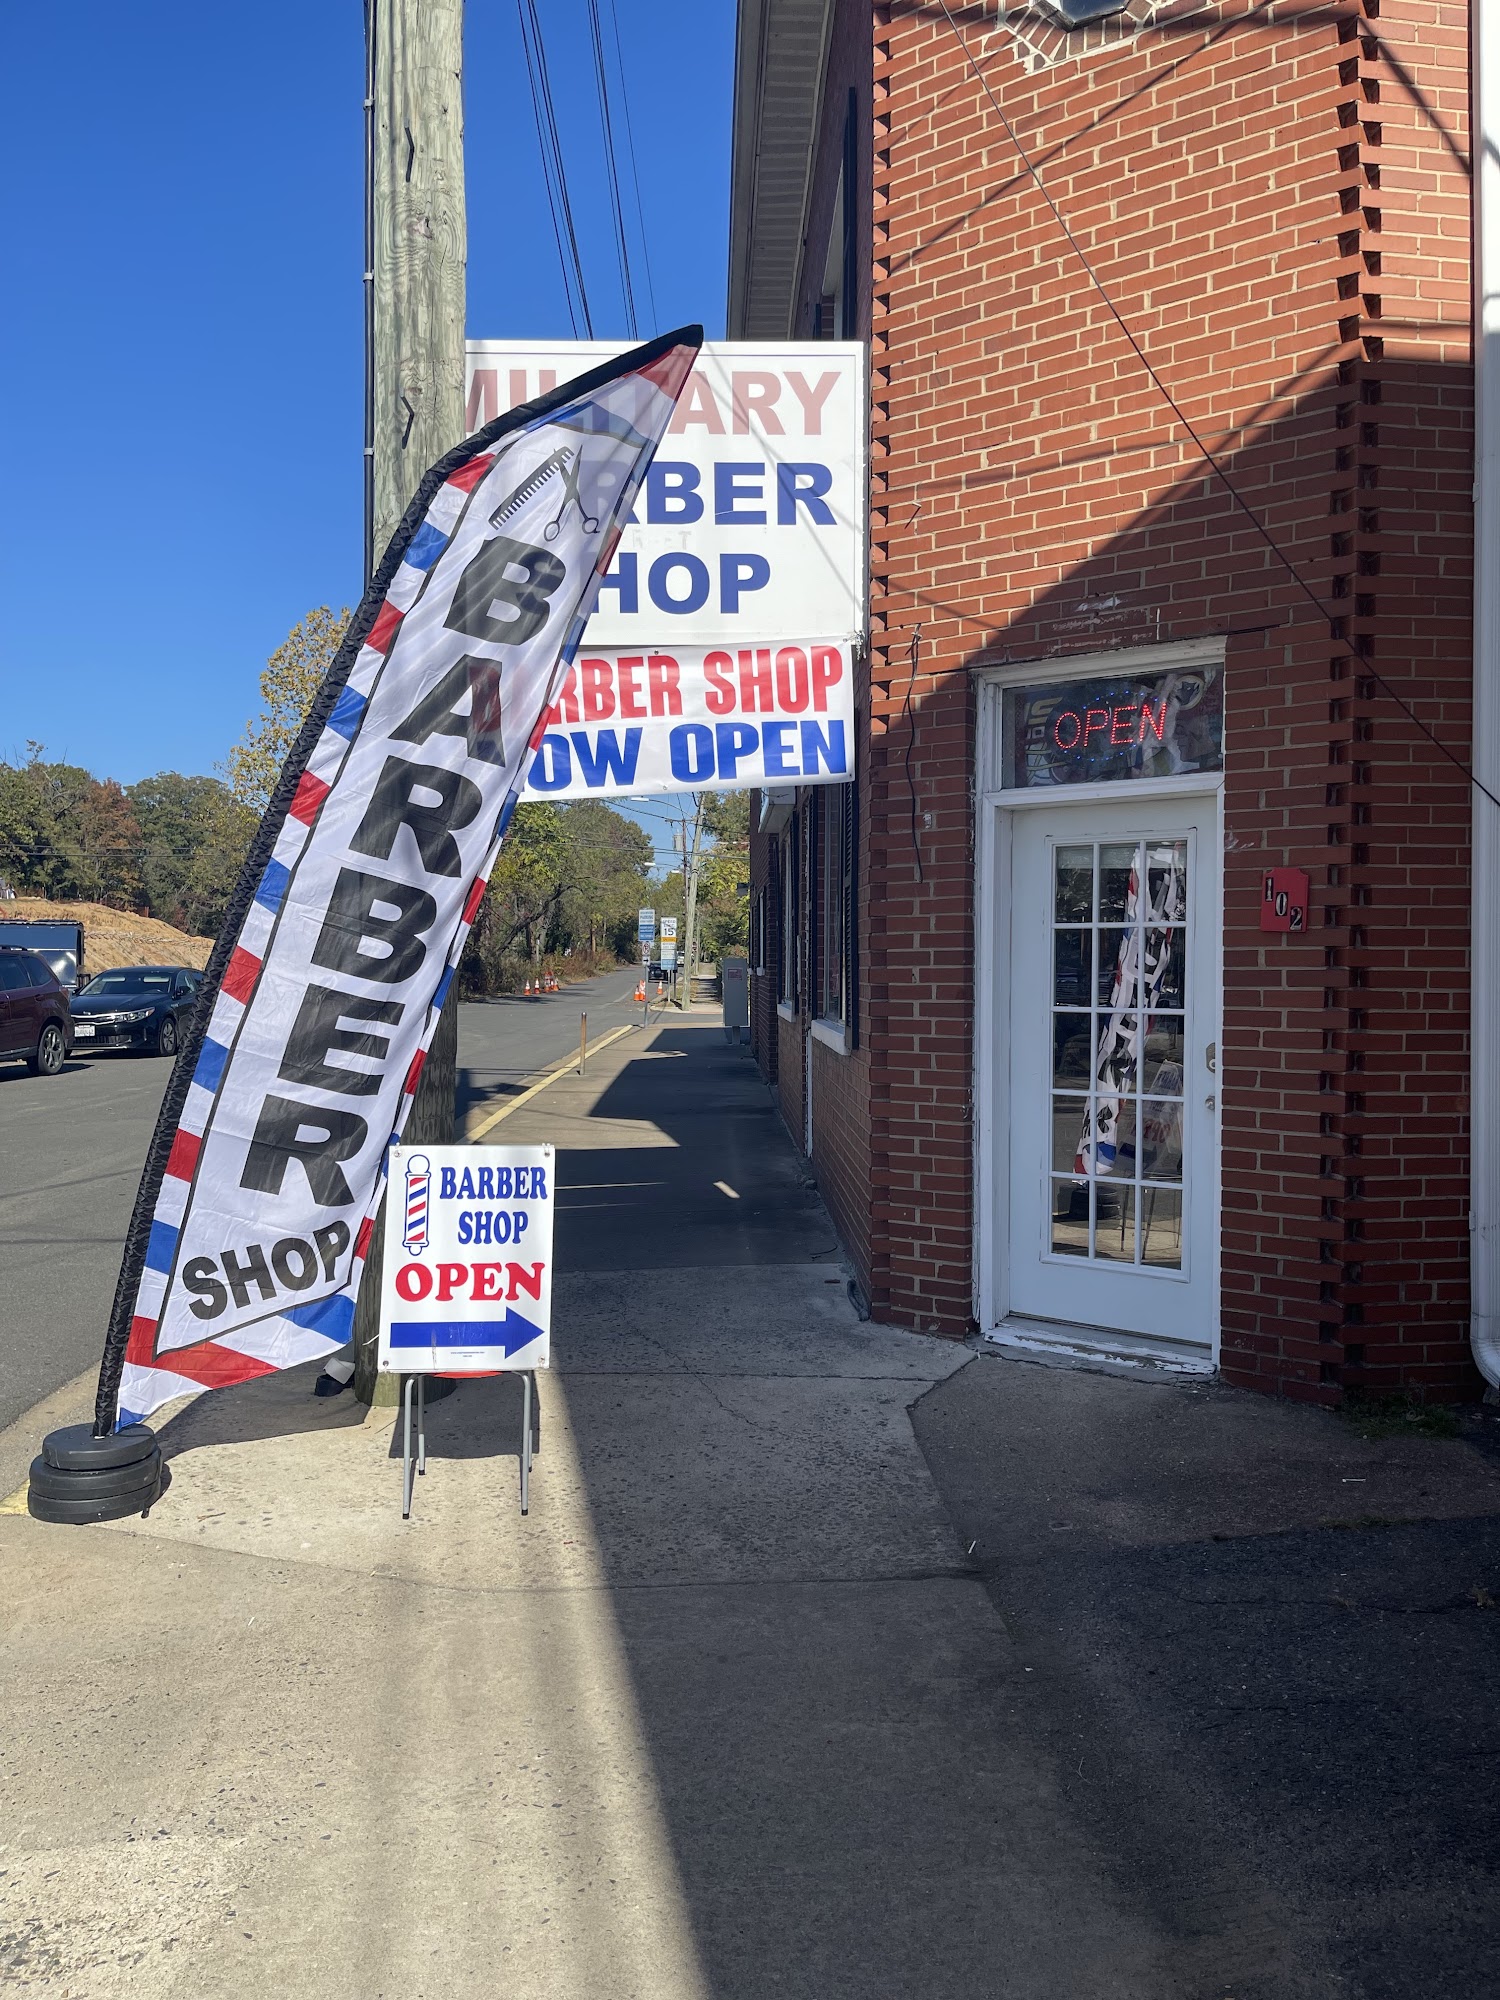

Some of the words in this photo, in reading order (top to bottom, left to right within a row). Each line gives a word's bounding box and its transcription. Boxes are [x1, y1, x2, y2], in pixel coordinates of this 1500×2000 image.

[580, 461, 839, 526] RBER
[580, 551, 772, 615] HOP
[703, 645, 844, 715] SHOP
[1054, 702, 1167, 750] OPEN
[521, 727, 644, 793] OW
[669, 720, 848, 784] OPEN
[239, 536, 566, 1207] BARBER
[664, 928, 674, 936] 15
[1265, 878, 1303, 931] 102
[439, 1166, 548, 1200] BARBER
[457, 1210, 529, 1245] SHOP
[182, 1220, 351, 1321] SHOP
[395, 1261, 546, 1302] OPEN
